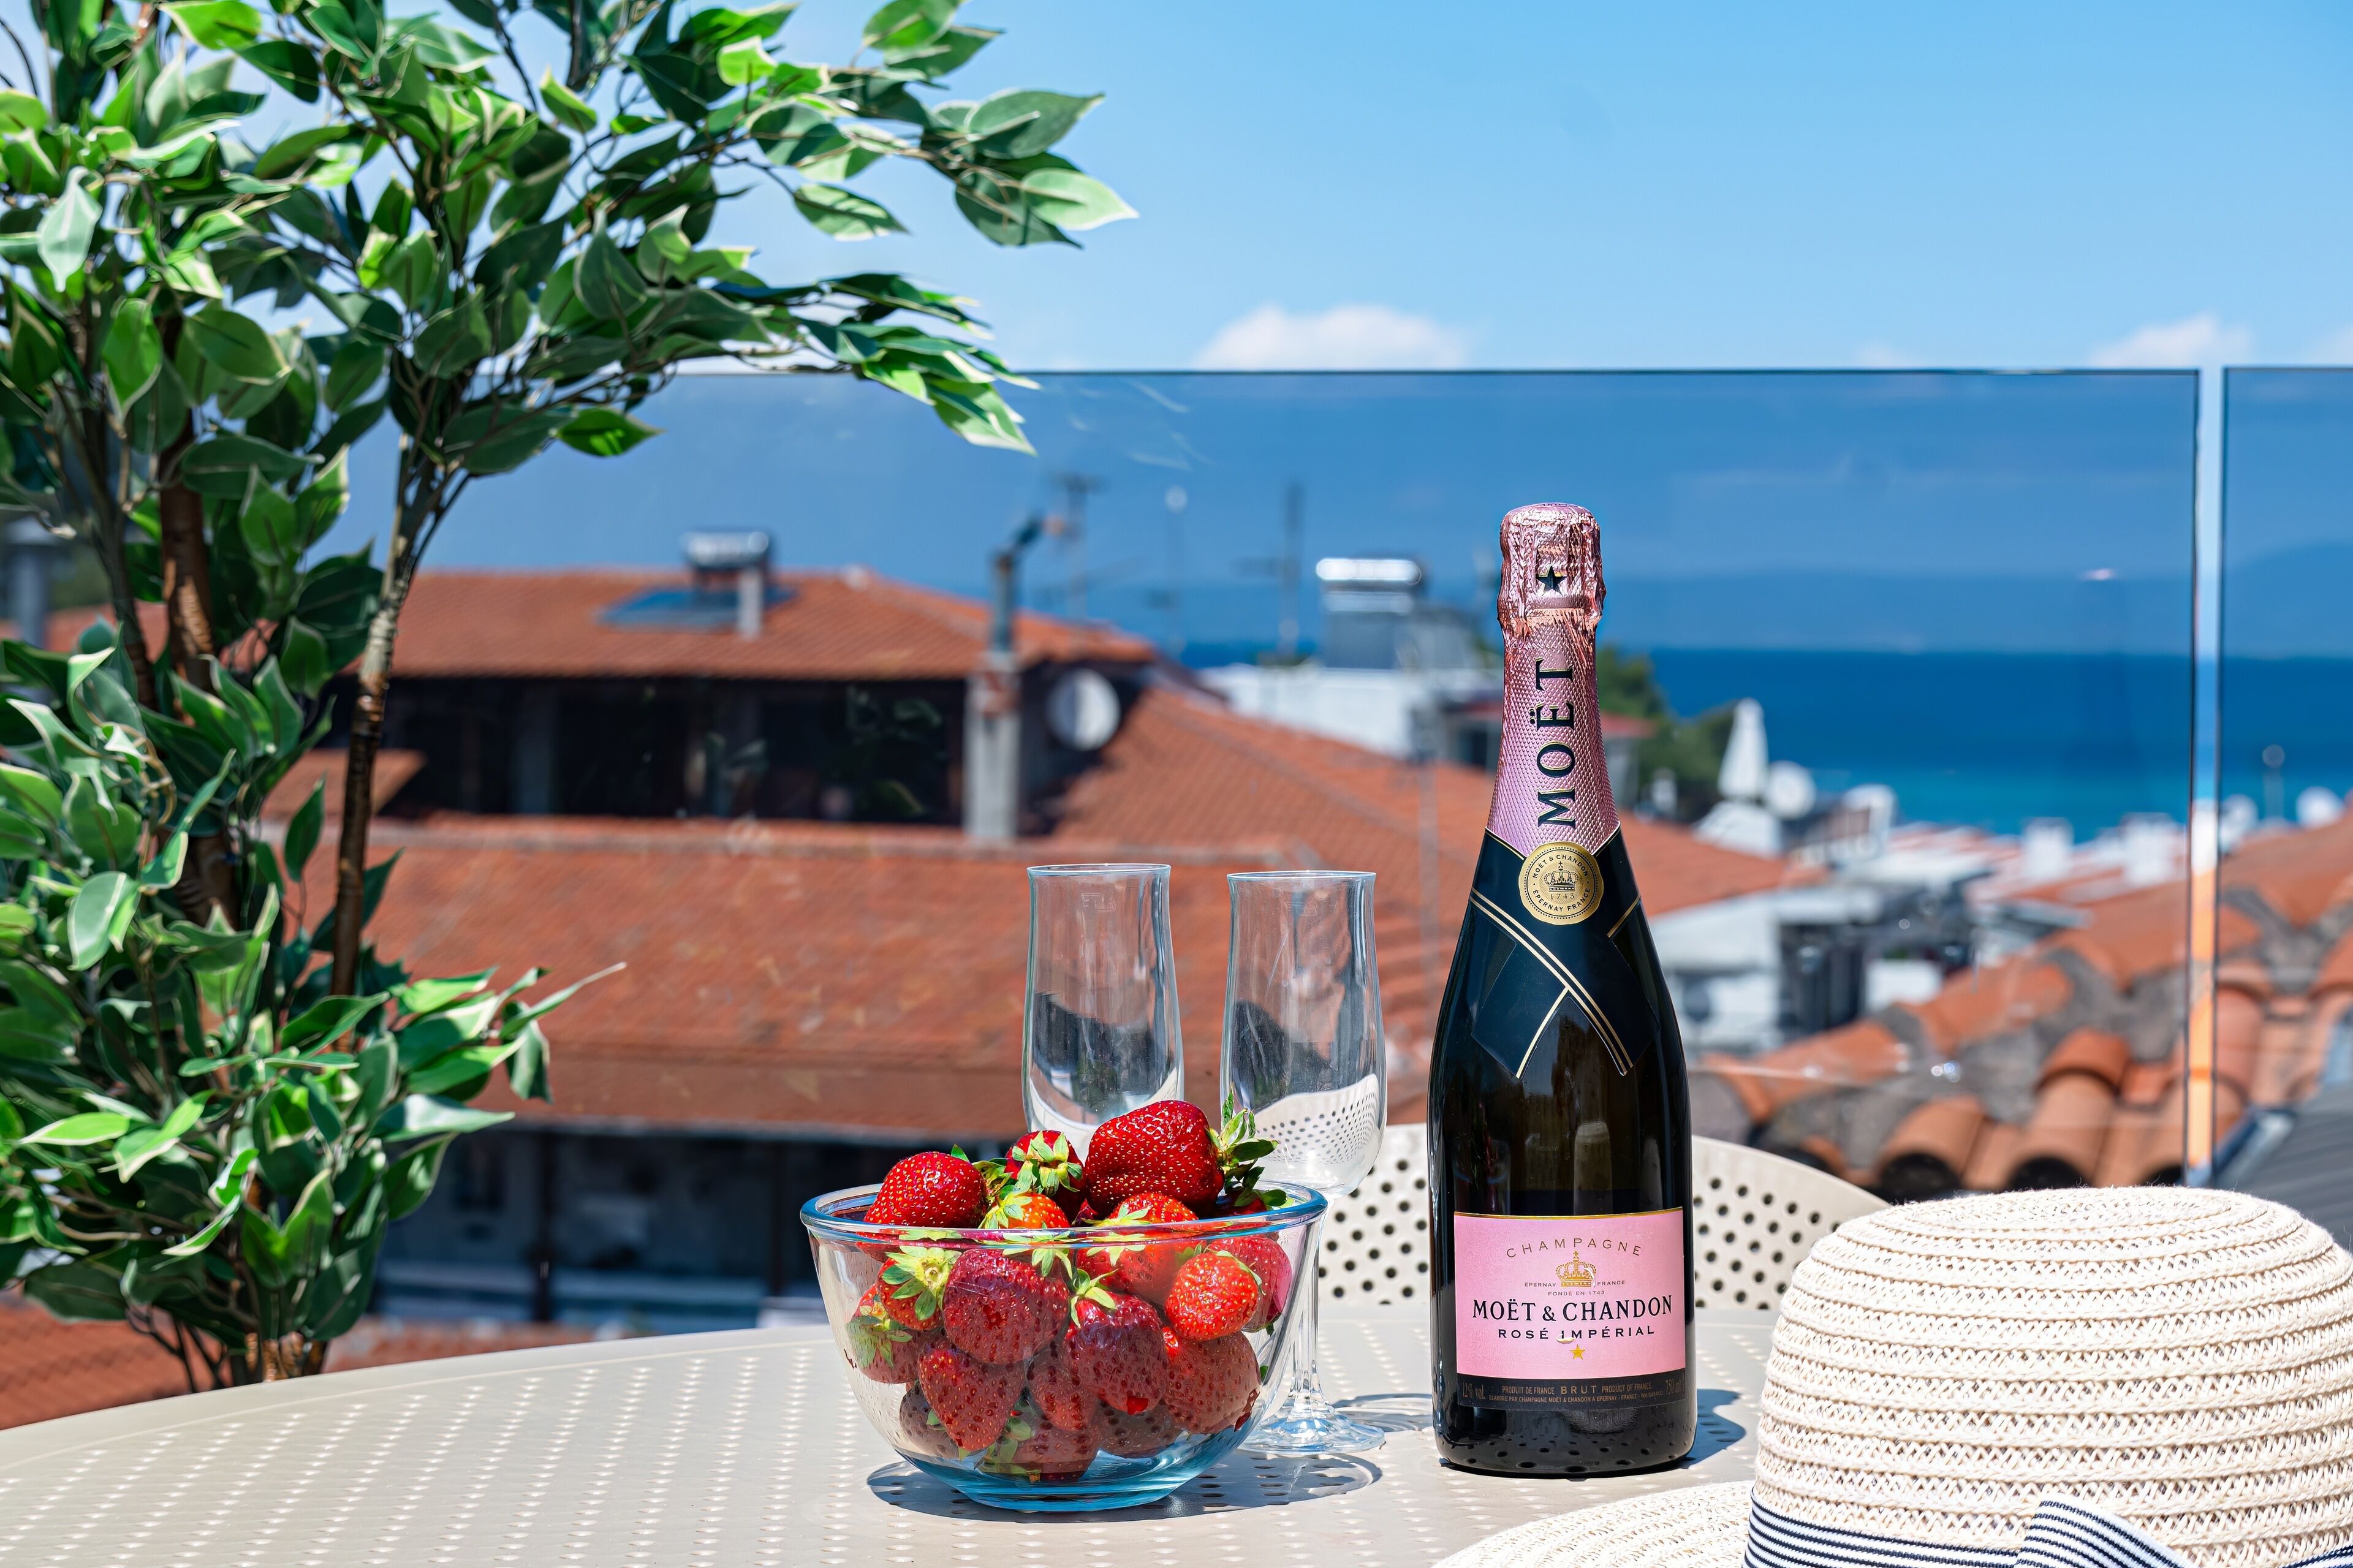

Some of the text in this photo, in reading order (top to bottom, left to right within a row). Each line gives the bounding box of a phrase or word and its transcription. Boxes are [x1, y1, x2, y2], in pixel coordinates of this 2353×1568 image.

[1529, 656, 1575, 828] MOËT
[1533, 859, 1547, 879] MOËT
[1556, 854, 1589, 877] CHANDON
[1533, 888, 1591, 912] ÉPERNAY FRANCE
[1506, 1238, 1642, 1259] CHAMPAGNE
[1472, 1295, 1672, 1322] MOËT & CHANDON
[1498, 1325, 1654, 1339] ROSÉ IMPÉRIAL
[1502, 1385, 1524, 1395] PRODUIT
[1561, 1385, 1597, 1395] BRUT
[1602, 1384, 1626, 1393] PRODUCT
[1634, 1382, 1651, 1390] FRANCE
